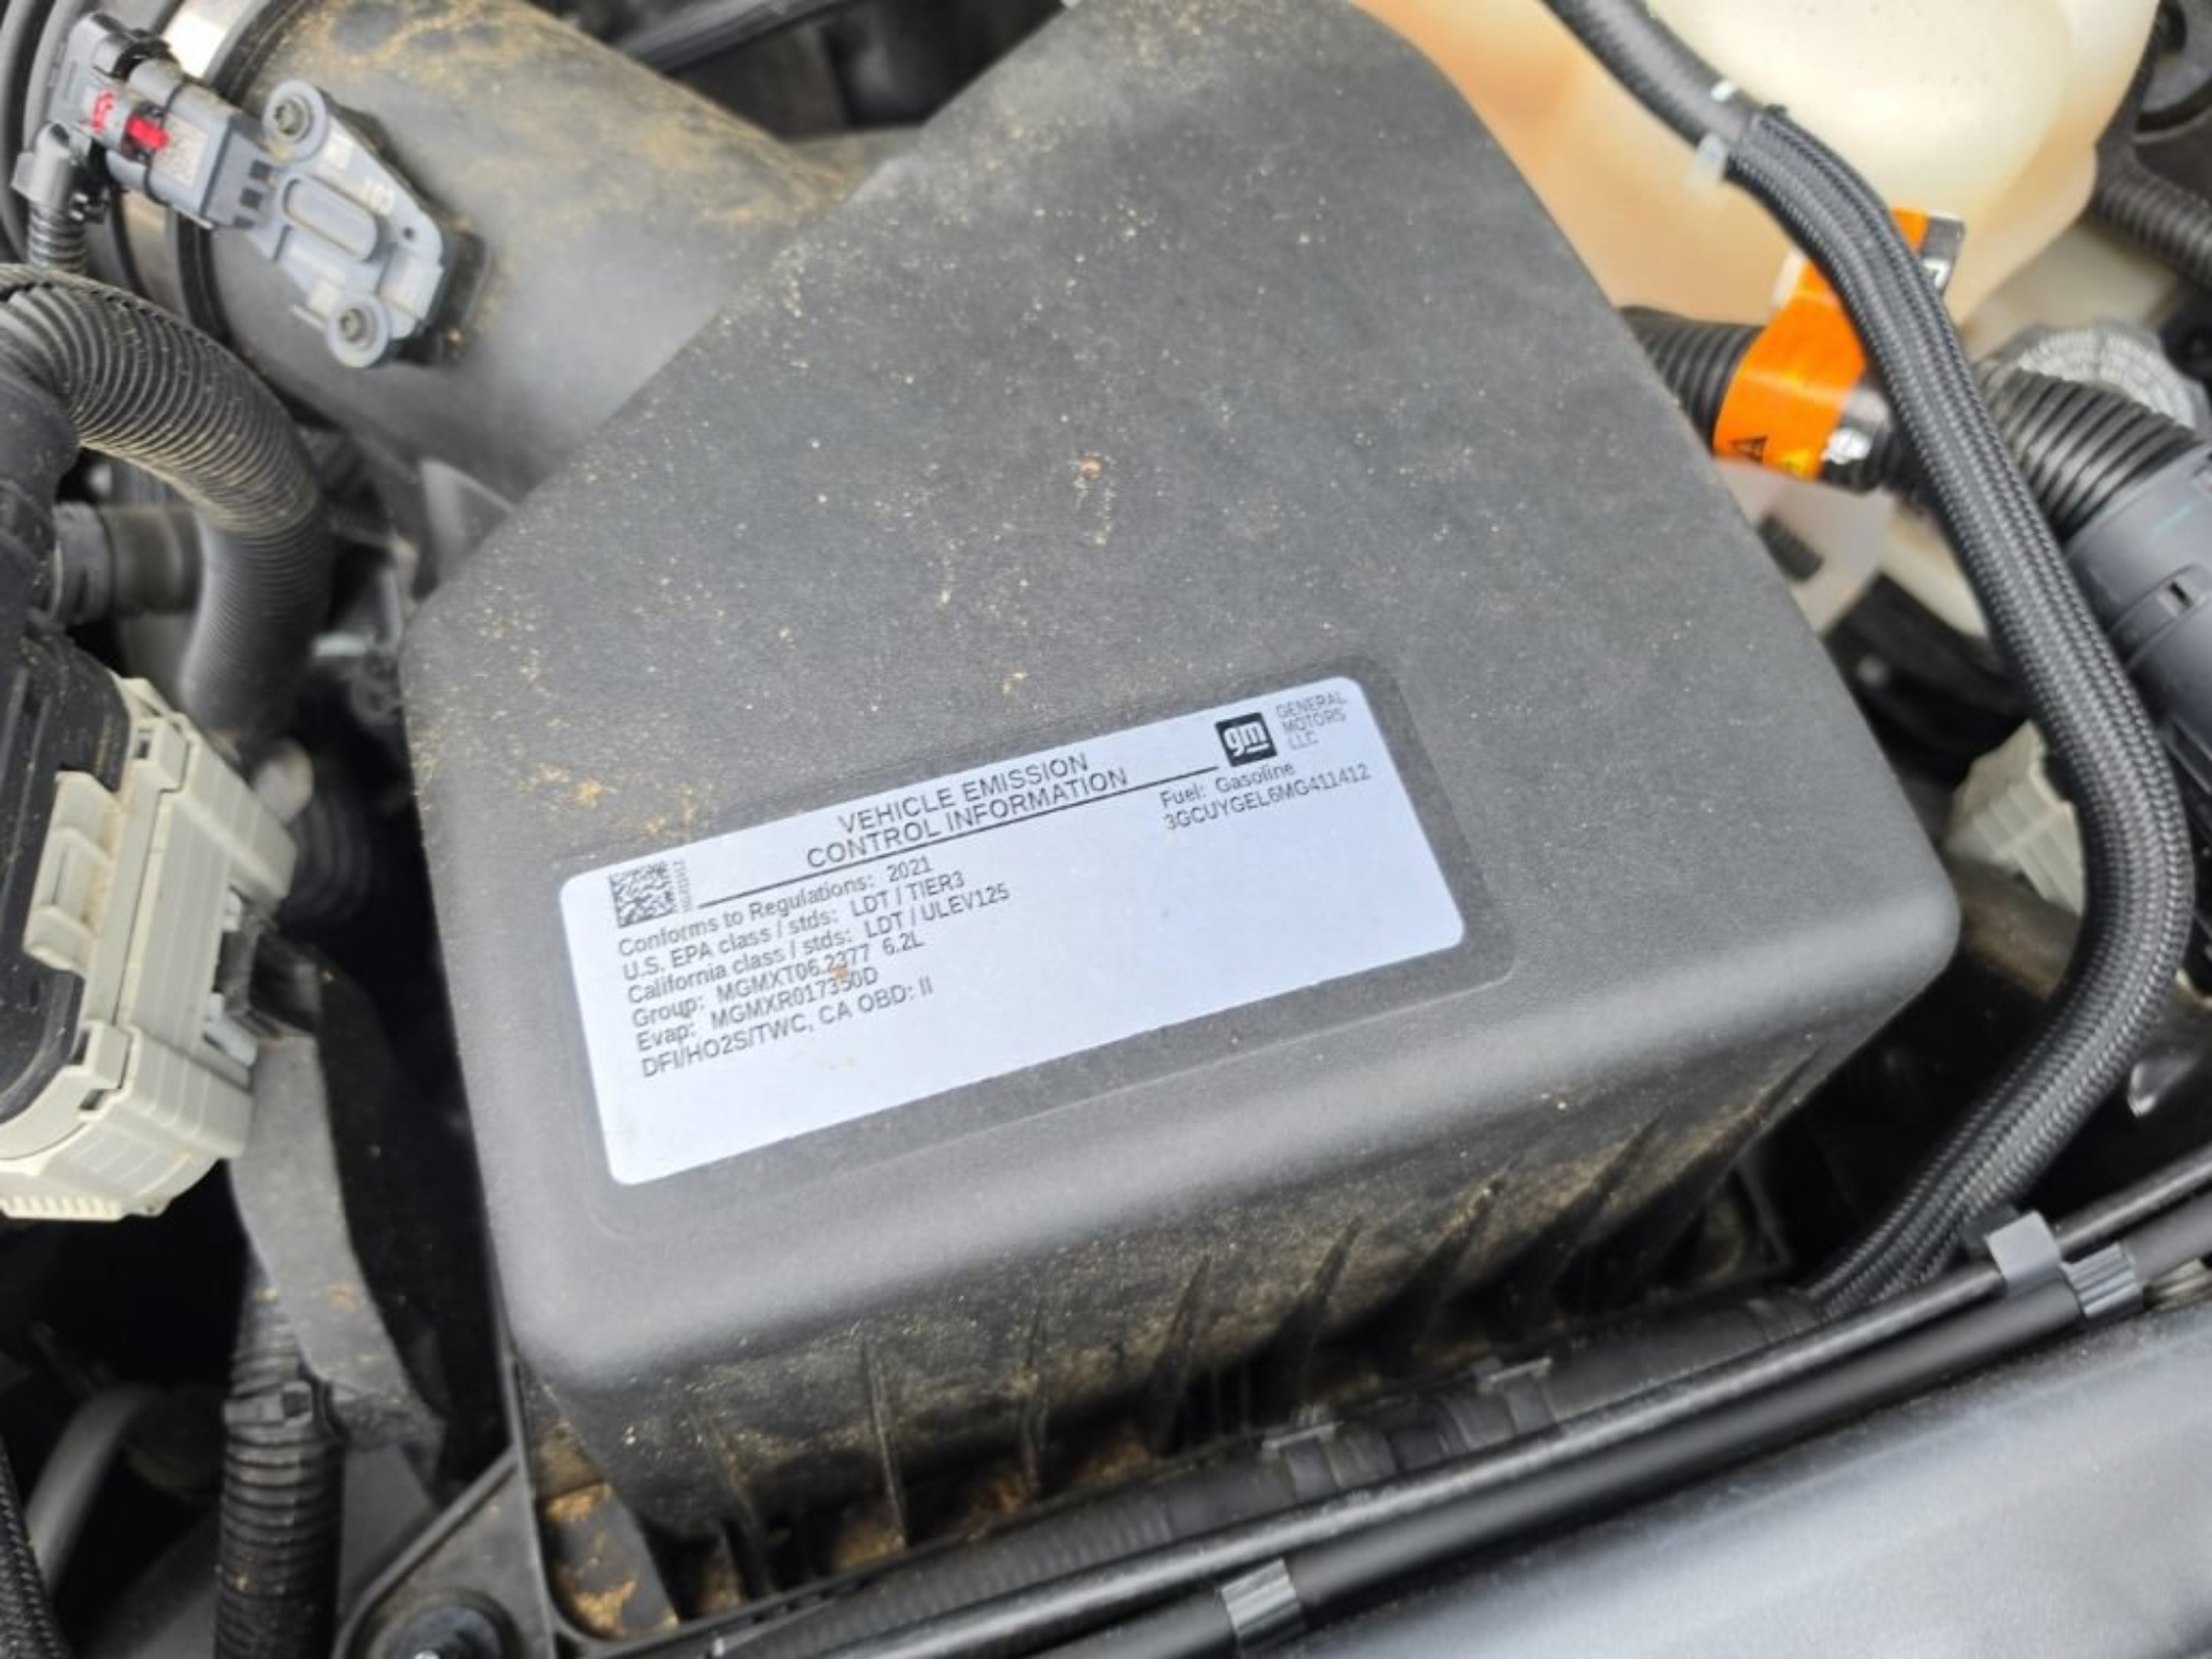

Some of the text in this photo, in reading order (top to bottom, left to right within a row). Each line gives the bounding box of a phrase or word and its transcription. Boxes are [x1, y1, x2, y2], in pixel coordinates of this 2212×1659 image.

[1275, 690, 1348, 718] GENERAL
[1278, 707, 1347, 732] MOTORS
[1286, 730, 1320, 750] LLC
[838, 752, 1089, 833] VEHICLE EMISSION
[1160, 763, 1296, 808] Fuel: Gasoline
[806, 767, 1128, 868] CONTROL INFORMATION
[618, 856, 934, 956] Conforms to Regulations: 2021
[622, 955, 666, 981] U.S.
[671, 940, 715, 969] EPA
[718, 925, 773, 954] class
[788, 909, 839, 934] stds:
[849, 890, 888, 917] LDT
[906, 870, 965, 901] TIER3
[628, 962, 727, 1004] California
[732, 947, 786, 975] class
[803, 930, 853, 955] stds:
[863, 911, 902, 939] LDT
[922, 882, 1010, 921] ULEV125
[632, 930, 926, 1028] Group: MGMXT06.2377 6.2L
[818, 1001, 853, 1025] CA
[856, 983, 916, 1013] OBD:
[636, 1022, 697, 1052] Evap:
